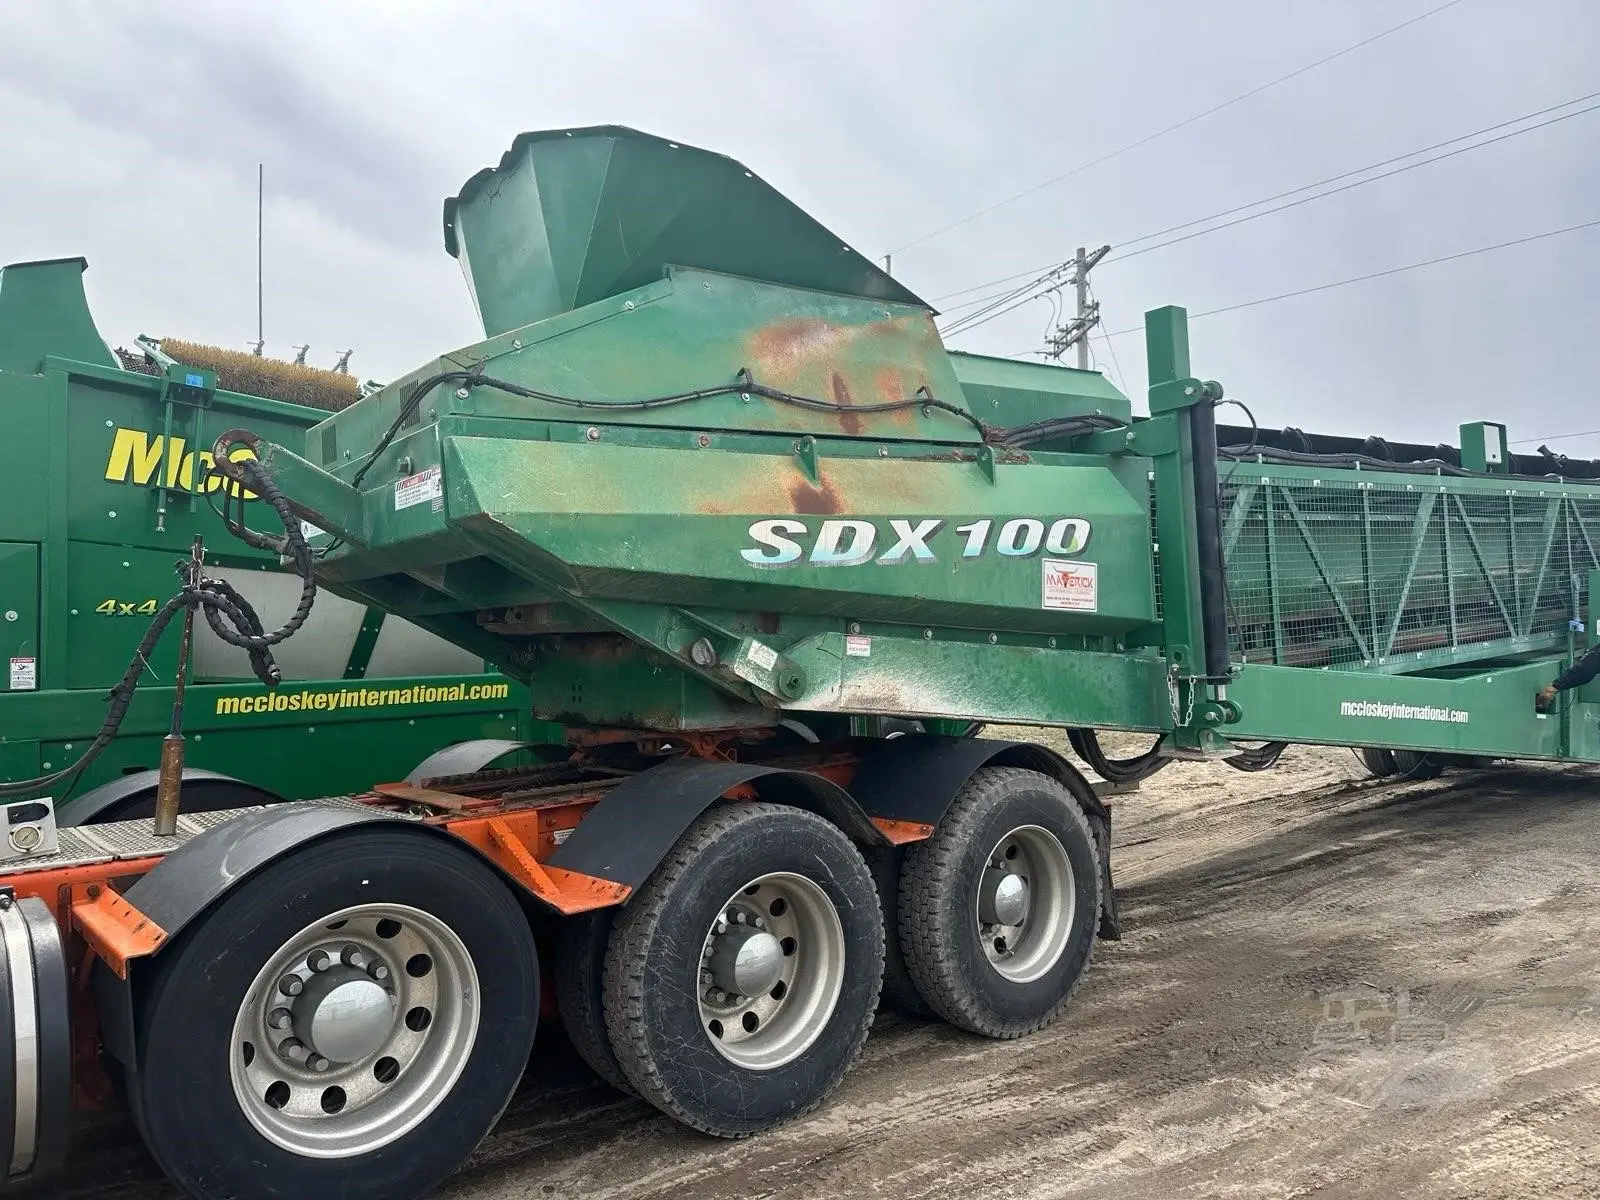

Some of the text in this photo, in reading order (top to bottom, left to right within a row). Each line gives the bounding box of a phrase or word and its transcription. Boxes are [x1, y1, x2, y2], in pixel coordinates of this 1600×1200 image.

[740, 518, 1093, 568] SDX 100
[95, 599, 157, 616] 4x4
[216, 683, 508, 715] mccloskeyinternational.com
[1340, 700, 1469, 723] mccloskeyinternational.com
